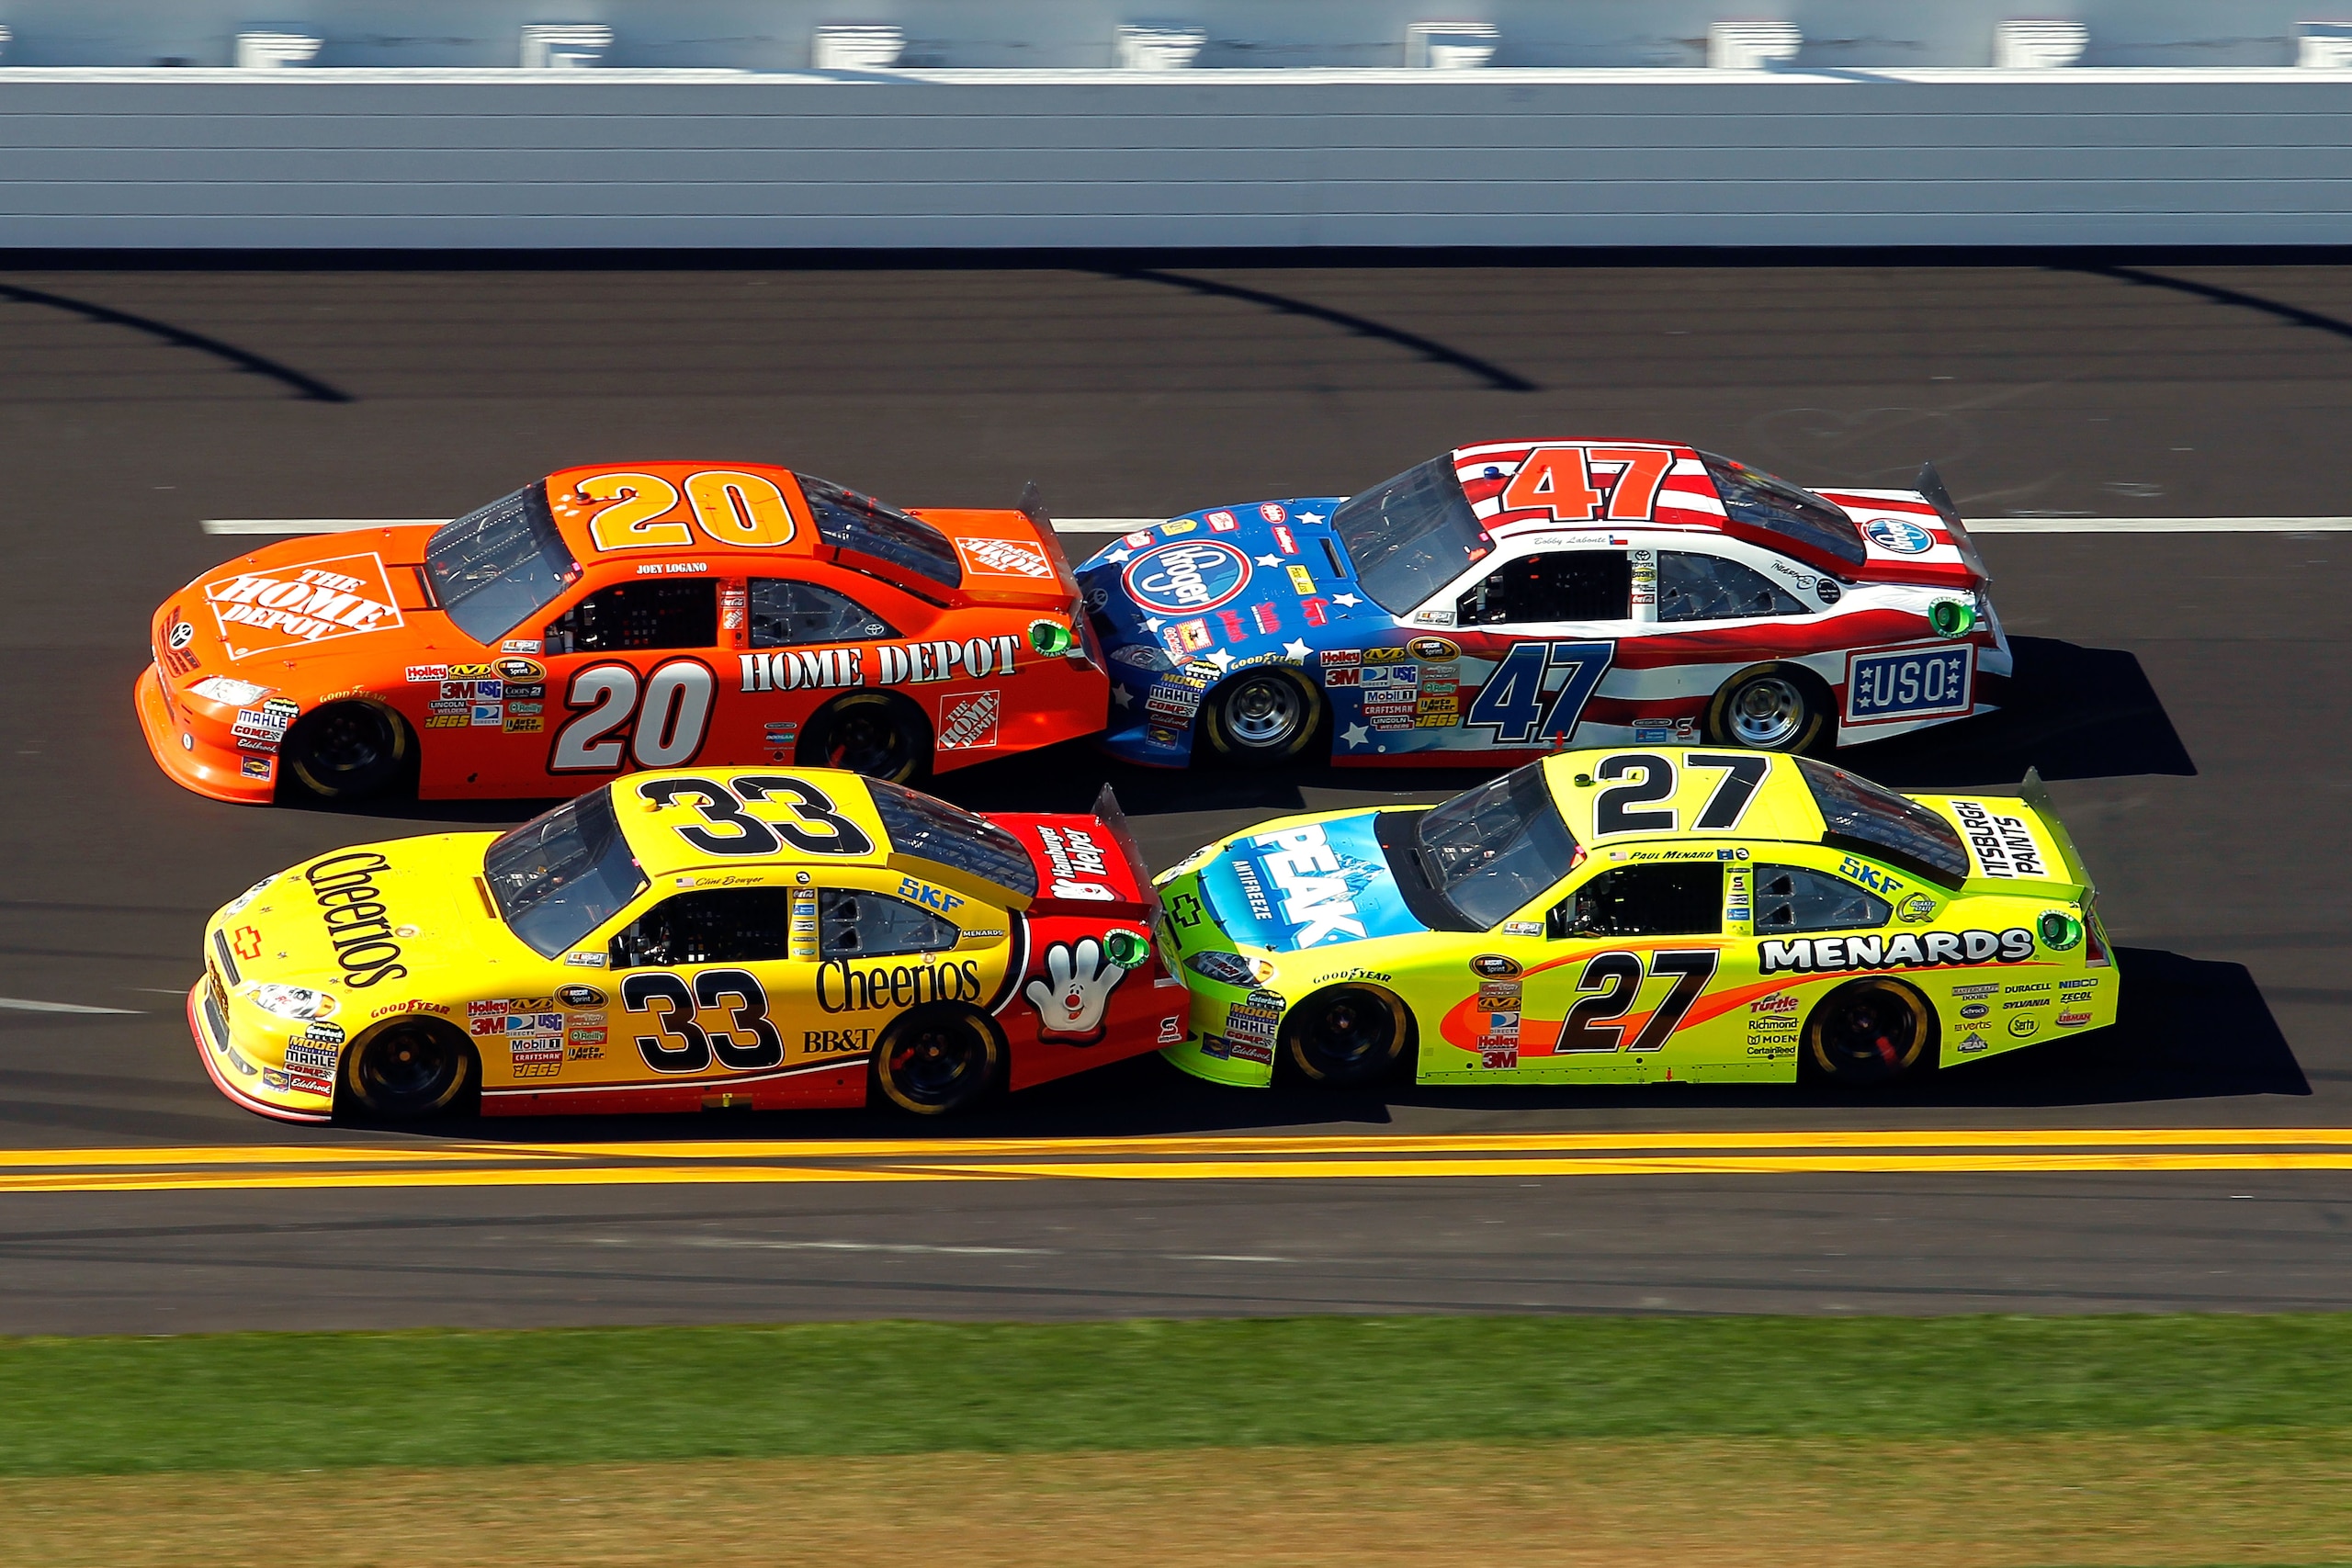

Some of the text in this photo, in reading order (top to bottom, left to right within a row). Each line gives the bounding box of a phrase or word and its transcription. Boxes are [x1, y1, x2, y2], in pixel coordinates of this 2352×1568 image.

[1498, 446, 1676, 523] 47
[575, 470, 797, 551] 20
[1876, 520, 1925, 551] Kroger
[637, 562, 707, 574] JOEY LOGANO
[1141, 546, 1227, 604] Kroger
[294, 569, 367, 592] THE
[211, 576, 397, 632] HOME
[1930, 596, 1966, 608] AMERICAN
[220, 604, 336, 641] DEPOT
[1027, 619, 1063, 633] AMERICAN
[1035, 646, 1070, 658] ETHANOL
[1322, 650, 1360, 662] Holley
[738, 635, 1021, 693] HOME DEPOT
[1230, 653, 1302, 670] GOODYEAR
[407, 667, 447, 678] Holley
[1161, 672, 1208, 689] MOOG
[1327, 670, 1360, 685] 3M
[1393, 666, 1416, 682] USG
[477, 681, 502, 699] USG
[1872, 658, 1946, 706] USO
[319, 686, 387, 703] GOODYEAR
[442, 682, 475, 699] 3M
[505, 686, 530, 695] Coors
[1151, 686, 1199, 704] MAHLE
[1368, 692, 1400, 702] Mobil
[1464, 639, 1617, 742] 47
[510, 703, 543, 713] O'Reilly
[945, 700, 970, 723] THE
[1148, 701, 1185, 713] COMP
[1364, 705, 1413, 714] CRAFTSMAN
[238, 710, 287, 728] MAHLE
[428, 716, 470, 728] JEGS
[548, 658, 717, 773] 20
[939, 691, 999, 749] HOME
[1150, 714, 1189, 728] Edelbrock
[1420, 714, 1459, 728] JEGS
[234, 725, 271, 738] COMP
[960, 711, 997, 748] DEPOT
[237, 738, 277, 753] Edelbrock
[1592, 752, 1772, 840] 27
[637, 774, 875, 856] 33
[1035, 825, 1076, 878] Hamburger
[1062, 827, 1107, 875] Helper
[1993, 817, 2044, 874] PAINTS
[1630, 851, 1714, 860] PAUL MENARD
[695, 875, 764, 886] Clint Bowyer
[1838, 856, 1904, 895] SKF
[898, 877, 966, 912] SKF
[1232, 860, 1273, 920] ANTIFREEZE
[1253, 824, 1369, 950] PEAK
[305, 852, 408, 988] Cheerios
[2039, 909, 2075, 921] AMERICAN
[963, 929, 1004, 937] MENARDS
[1103, 928, 1140, 942] AMERICAN
[2042, 936, 2080, 950] ETHANOL
[1758, 928, 2036, 975] MENARDS
[1109, 953, 1149, 969] ETHANOL
[1313, 968, 1392, 984] GOODYEAR
[2058, 978, 2098, 989] NIBCO
[816, 960, 981, 1013] Cheerios
[2005, 983, 2051, 994] DURACELL
[1249, 994, 1285, 1007] Gatorback
[1554, 949, 1720, 1054] 27
[2003, 998, 2050, 1010] SYLVANIA
[2061, 992, 2093, 1001] ZECOL
[370, 1000, 451, 1018] GOODYEAR
[468, 1001, 507, 1013] Holley
[1231, 1004, 1278, 1020] MOOG
[1750, 997, 1799, 1013] Turtle
[1962, 1007, 1984, 1015] Schrock
[538, 1014, 562, 1031] USG
[620, 969, 785, 1073] 33
[1748, 1018, 1797, 1030] Richmond
[1962, 1021, 1992, 1030] vertis
[2014, 1019, 2034, 1031] Serta
[2059, 1013, 2091, 1022] LIBMAN
[471, 1017, 504, 1035] 3M
[1227, 1017, 1275, 1035] MAHLE
[289, 1036, 338, 1051] MOOG
[571, 1031, 605, 1040] O'Reilly
[803, 1028, 875, 1053] BB&T
[1227, 1031, 1263, 1043] COMP
[1479, 1036, 1518, 1048] Holley
[1763, 1035, 1796, 1043] MOEN
[512, 1040, 546, 1050] Mobil
[1231, 1045, 1270, 1061] Edelbrock
[1747, 1046, 1795, 1055] CertainTeed
[1959, 1041, 1987, 1050] PEAK
[286, 1050, 336, 1067] MAHLE
[1483, 1052, 1517, 1068] 3M
[286, 1065, 323, 1076] COMP
[516, 1063, 561, 1077] JEGS
[291, 1077, 331, 1093] Edelbrock
